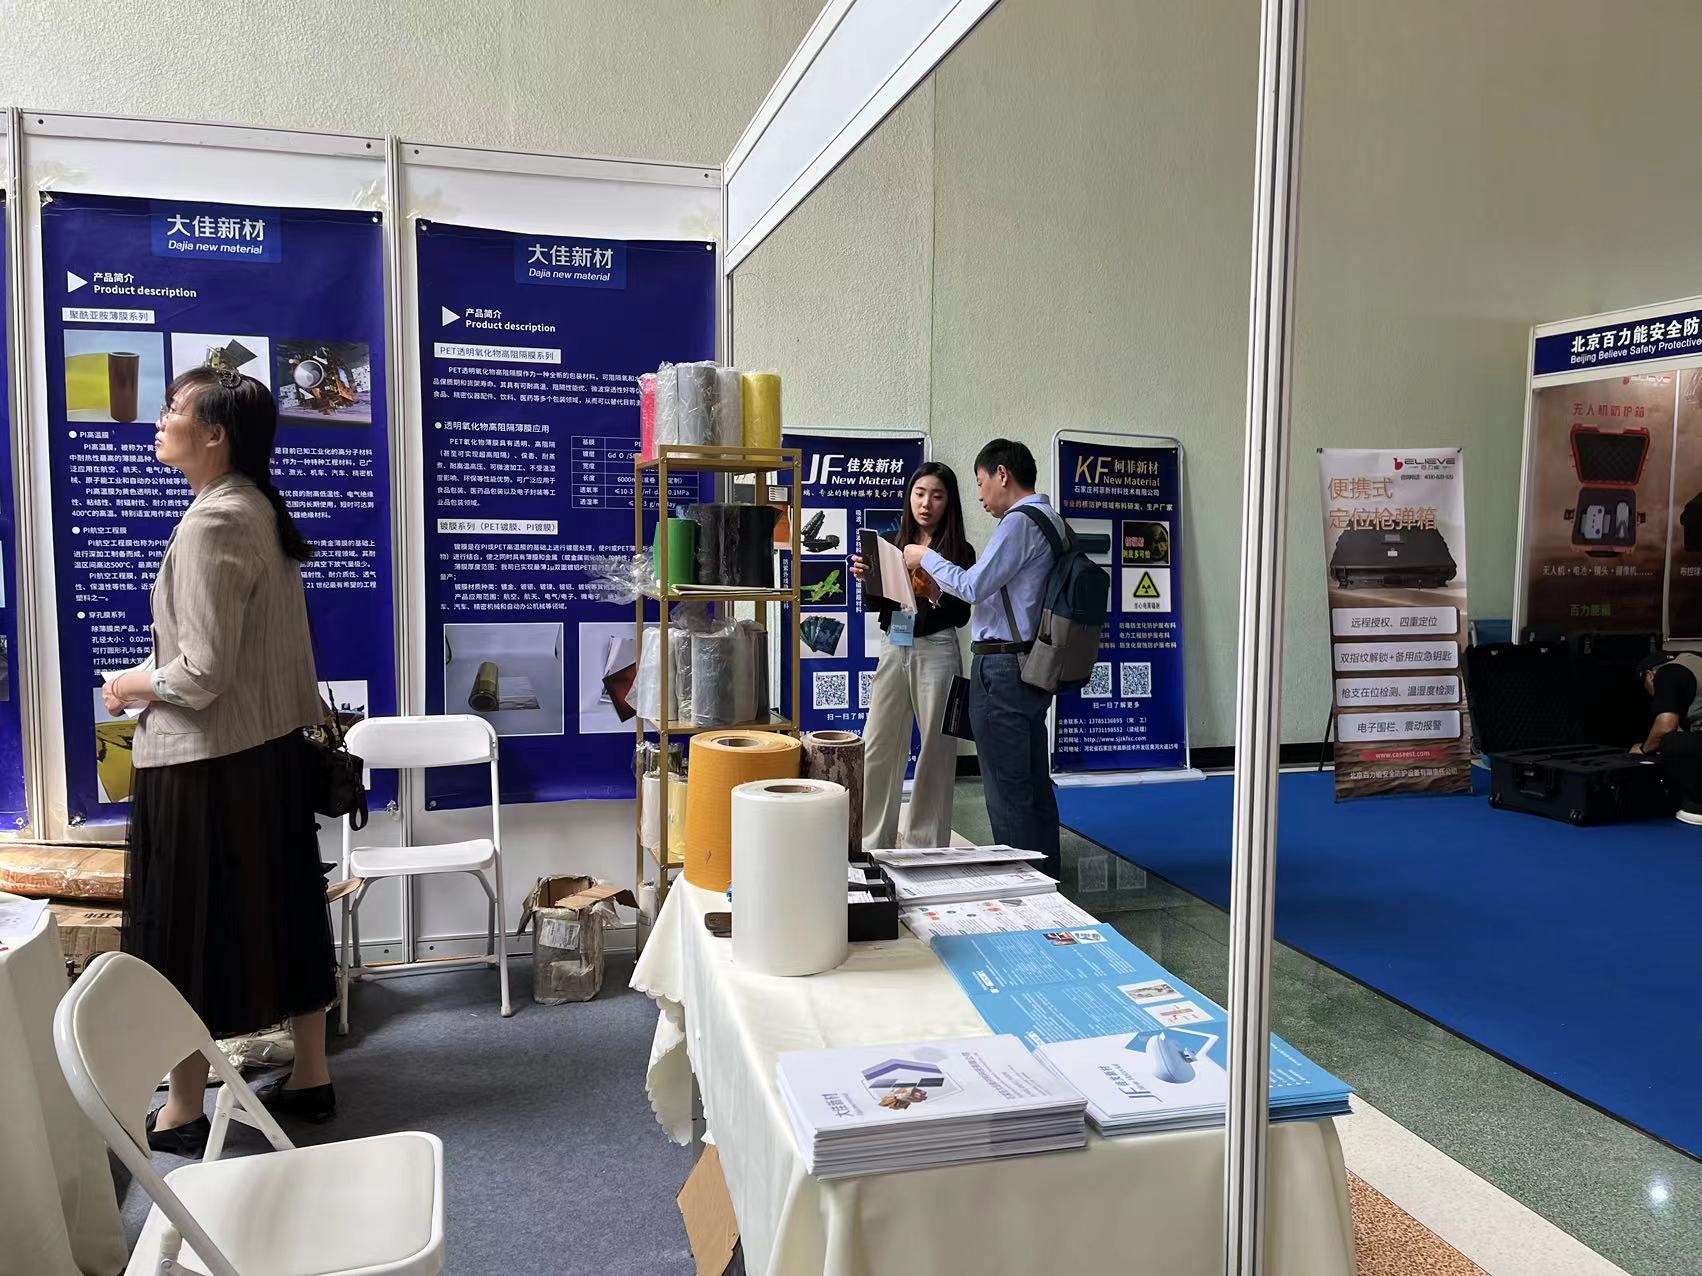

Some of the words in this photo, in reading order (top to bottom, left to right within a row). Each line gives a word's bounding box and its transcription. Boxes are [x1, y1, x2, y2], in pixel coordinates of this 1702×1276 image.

[167, 214, 265, 242] 大佳新材
[168, 240, 194, 254] Dajia
[196, 243, 218, 253] new
[220, 243, 263, 255] material
[527, 243, 613, 269] 大佳新材
[93, 272, 135, 284] 产品简介
[528, 268, 551, 279] Dajia
[553, 271, 573, 280] new
[574, 271, 610, 282] material
[93, 284, 135, 296] Product
[137, 286, 197, 299] description
[465, 307, 502, 319] 产品简介
[465, 320, 503, 331] Product
[504, 321, 556, 333] description
[1570, 316, 1701, 354] 北京百力能安全防
[439, 346, 555, 361] PET透明氧化物高阻隔膜系列
[1570, 352, 1597, 365] Beijing
[1598, 348, 1628, 361] Believe
[1630, 343, 1656, 357] Safety
[1658, 338, 1702, 351] Protective
[79, 431, 110, 439] PI高温膜
[443, 421, 550, 434] 透明氧化物高阻隔薄膜应用
[801, 453, 845, 485] JF
[846, 457, 904, 473] 佳发新材
[1075, 455, 1112, 484] KF
[1114, 459, 1160, 475] 柯菲新材
[831, 475, 856, 485] New
[858, 476, 905, 486] Material
[1103, 475, 1122, 485] New
[1123, 476, 1160, 487] Material
[1327, 475, 1393, 501] 便携式
[1328, 505, 1438, 531] 定位枪弹箱
[82, 527, 127, 535] PI航空工程膜
[91, 625, 153, 633] 除薄膜类产品，其
[1350, 615, 1439, 629] 远程授权、四重定位
[92, 647, 153, 655] 可打圆形孔与各类
[1356, 719, 1443, 734] 电子围栏、震动报警
